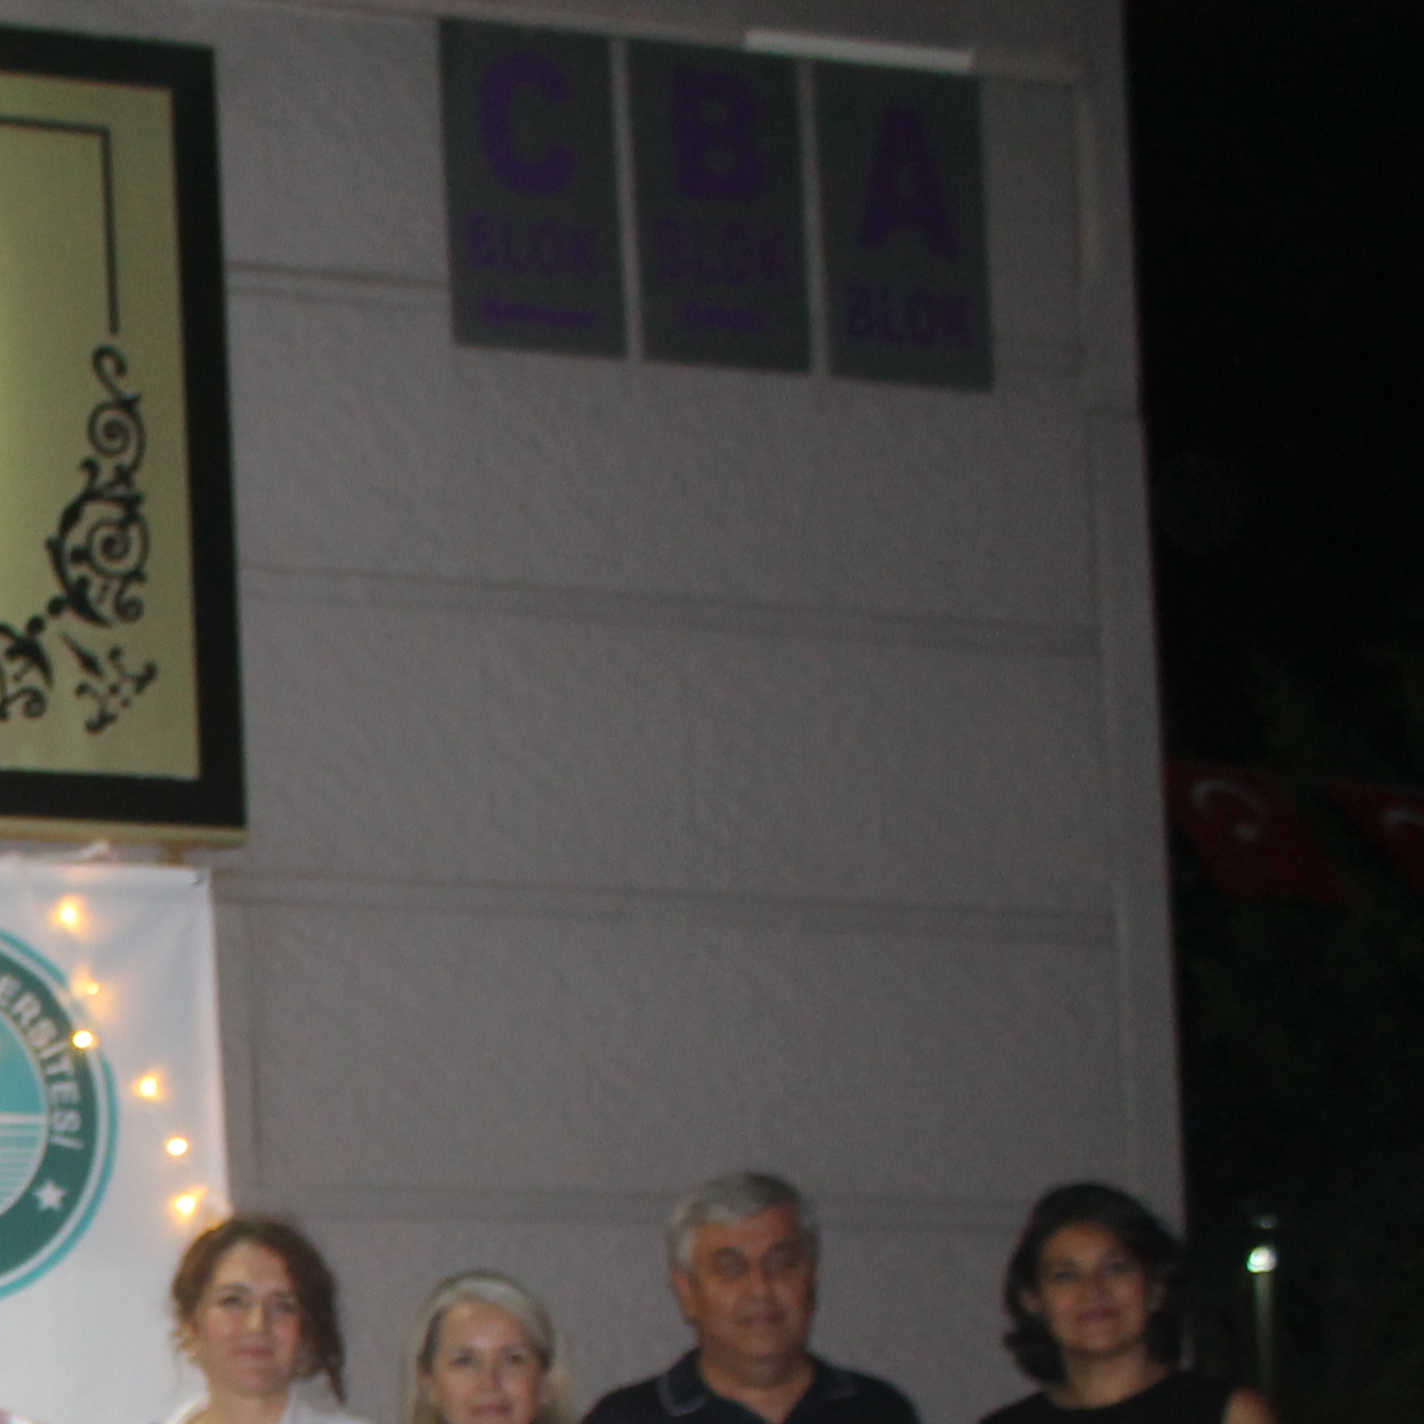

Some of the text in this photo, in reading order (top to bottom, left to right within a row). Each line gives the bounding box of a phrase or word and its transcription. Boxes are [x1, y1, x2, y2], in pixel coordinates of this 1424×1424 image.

[477, 50, 581, 197] C
[670, 67, 767, 203] B
[857, 107, 959, 258] A
[464, 213, 601, 279] BLOK
[652, 216, 791, 286] BLOK
[844, 280, 976, 350] BLOK
